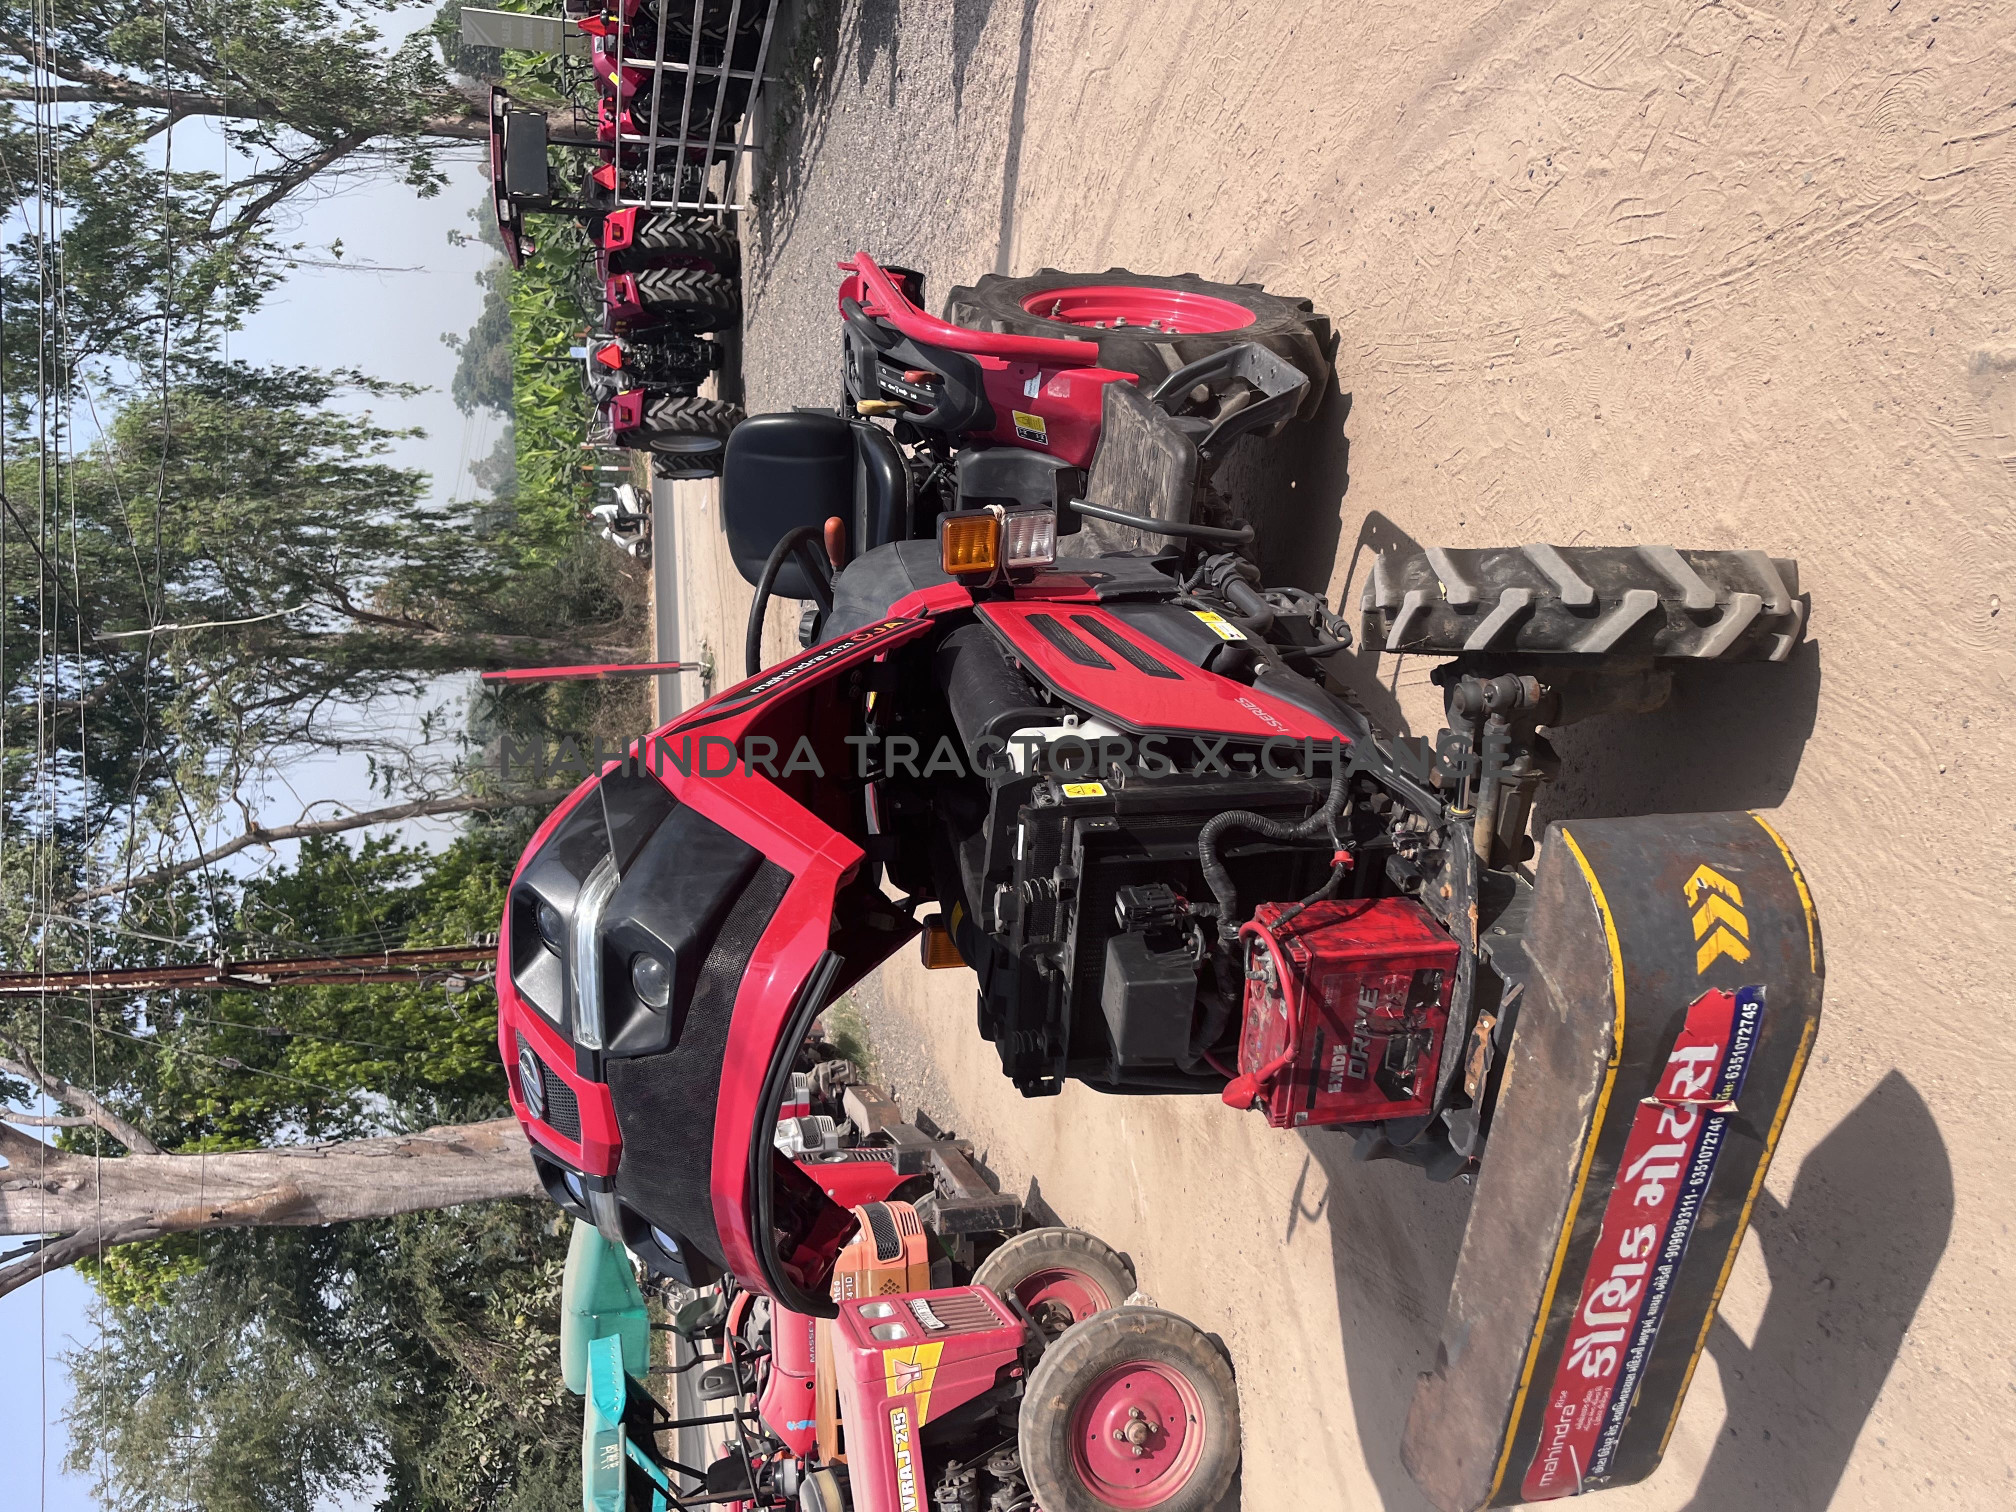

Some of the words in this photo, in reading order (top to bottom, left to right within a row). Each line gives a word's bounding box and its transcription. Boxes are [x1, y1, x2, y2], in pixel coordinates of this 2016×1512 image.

[750, 655, 828, 692] mahindra
[825, 642, 854, 655] 2121
[1726, 1003, 1758, 1078] 6351072745
[1327, 1045, 1347, 1093] EXIDE
[807, 1320, 815, 1363] MASSEY
[893, 1412, 908, 1445] 215
[1540, 1403, 1575, 1487] mahindra
